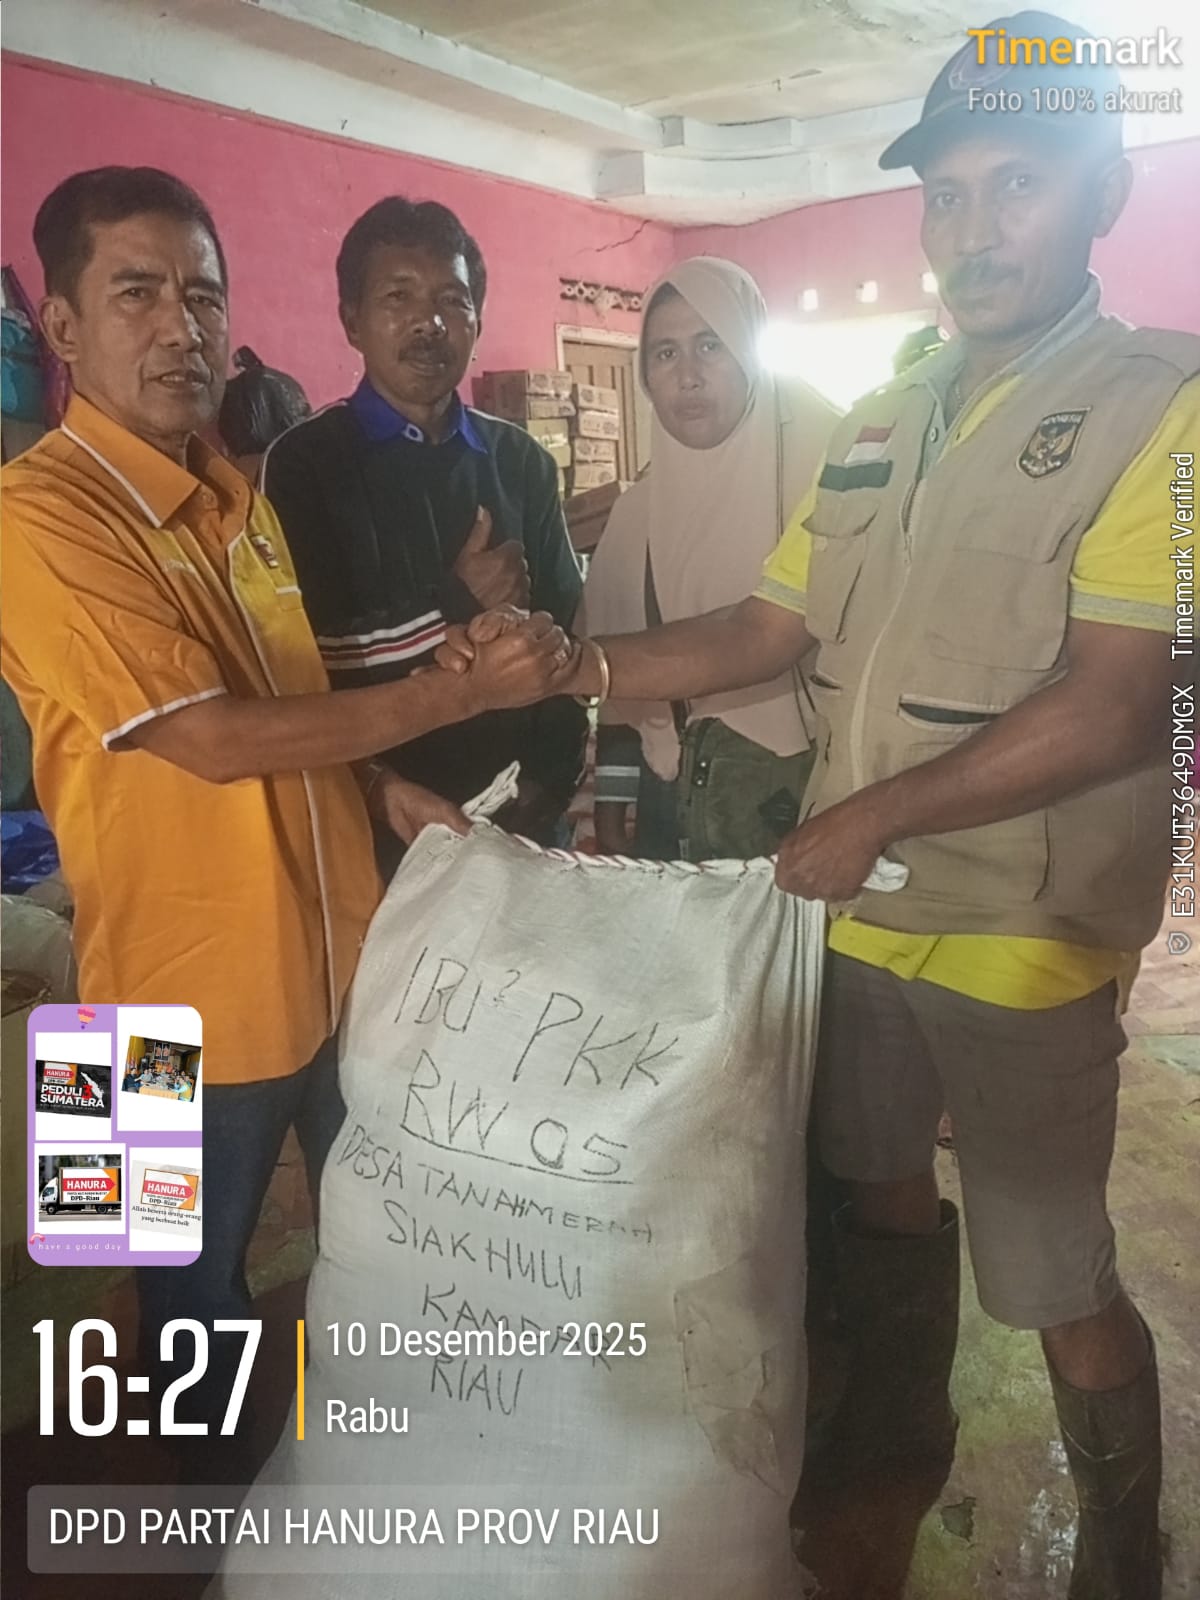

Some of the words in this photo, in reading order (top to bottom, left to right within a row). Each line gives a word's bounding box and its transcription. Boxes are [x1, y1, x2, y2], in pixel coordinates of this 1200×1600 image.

[512, 992, 679, 1090] PKK
[400, 1049, 509, 1150] RW
[337, 1124, 404, 1189] DESA
[431, 1351, 524, 1415] RIAU
